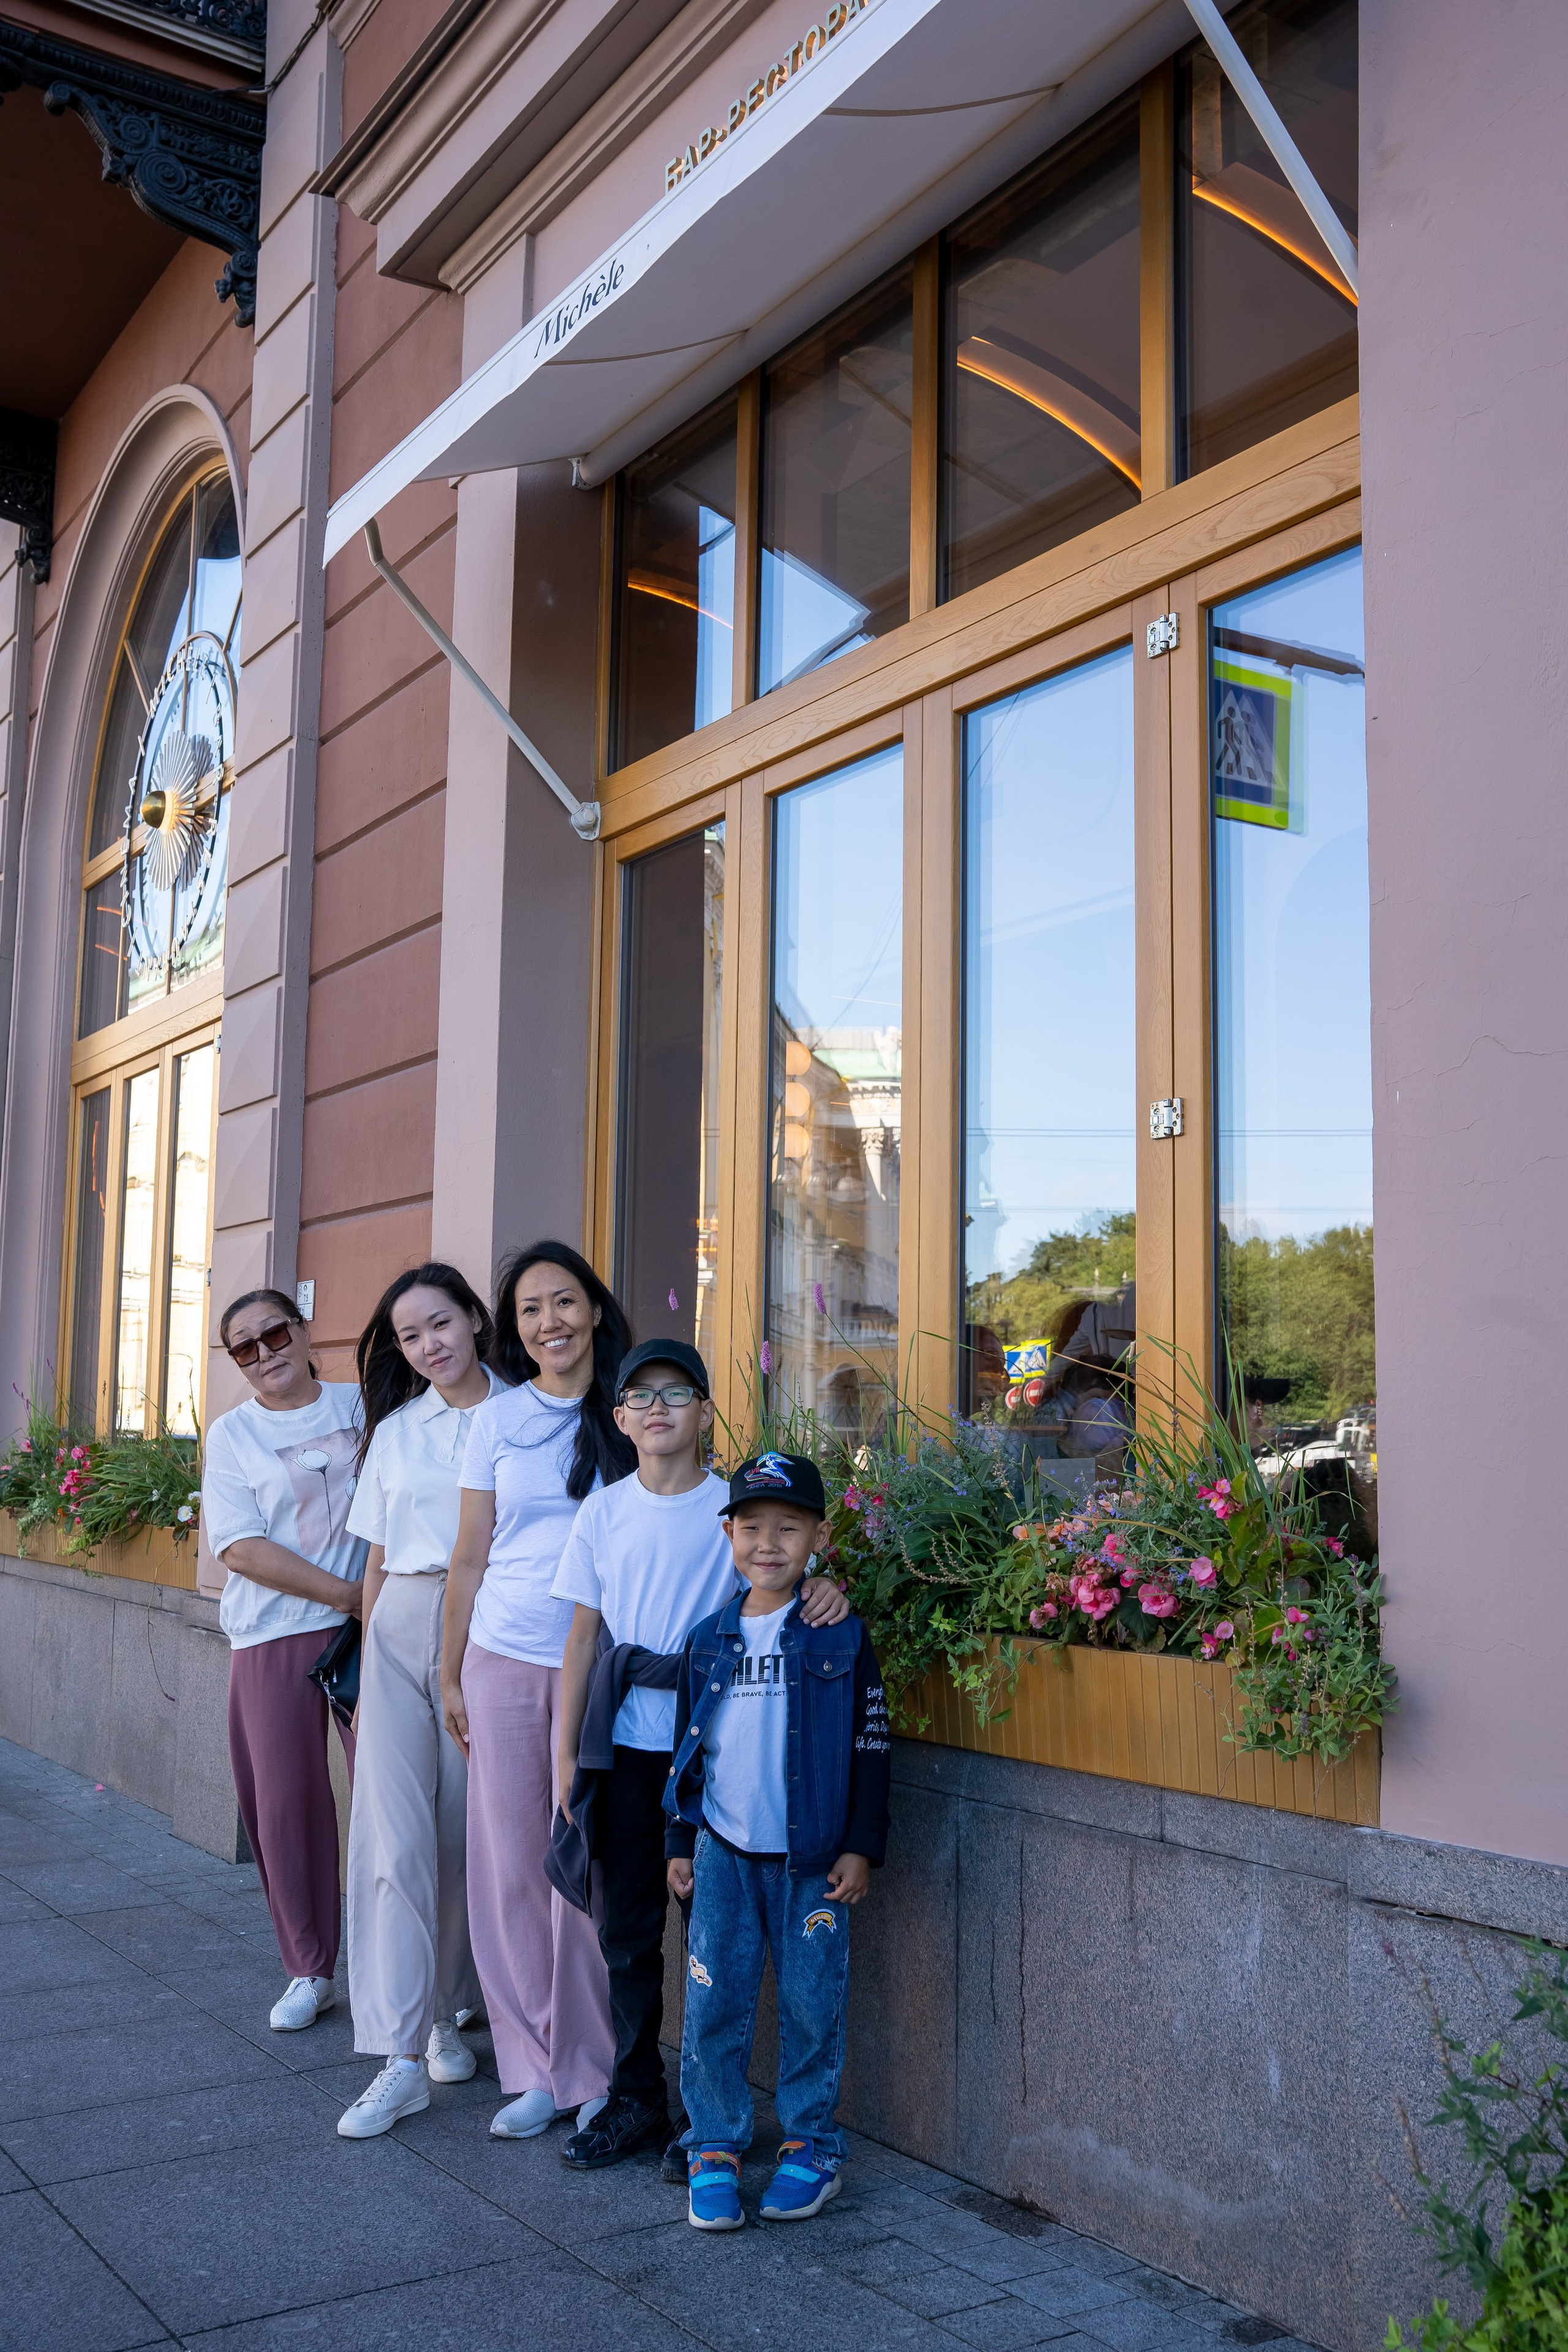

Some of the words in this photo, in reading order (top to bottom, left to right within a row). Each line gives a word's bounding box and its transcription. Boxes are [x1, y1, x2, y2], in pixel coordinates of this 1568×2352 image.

[665, 0, 866, 193] БАР-РЕСТОРА
[533, 258, 624, 358] Michèle
[731, 1654, 786, 1687] HLET
[866, 1702, 878, 1716] Good
[867, 1737, 882, 1750] Create
